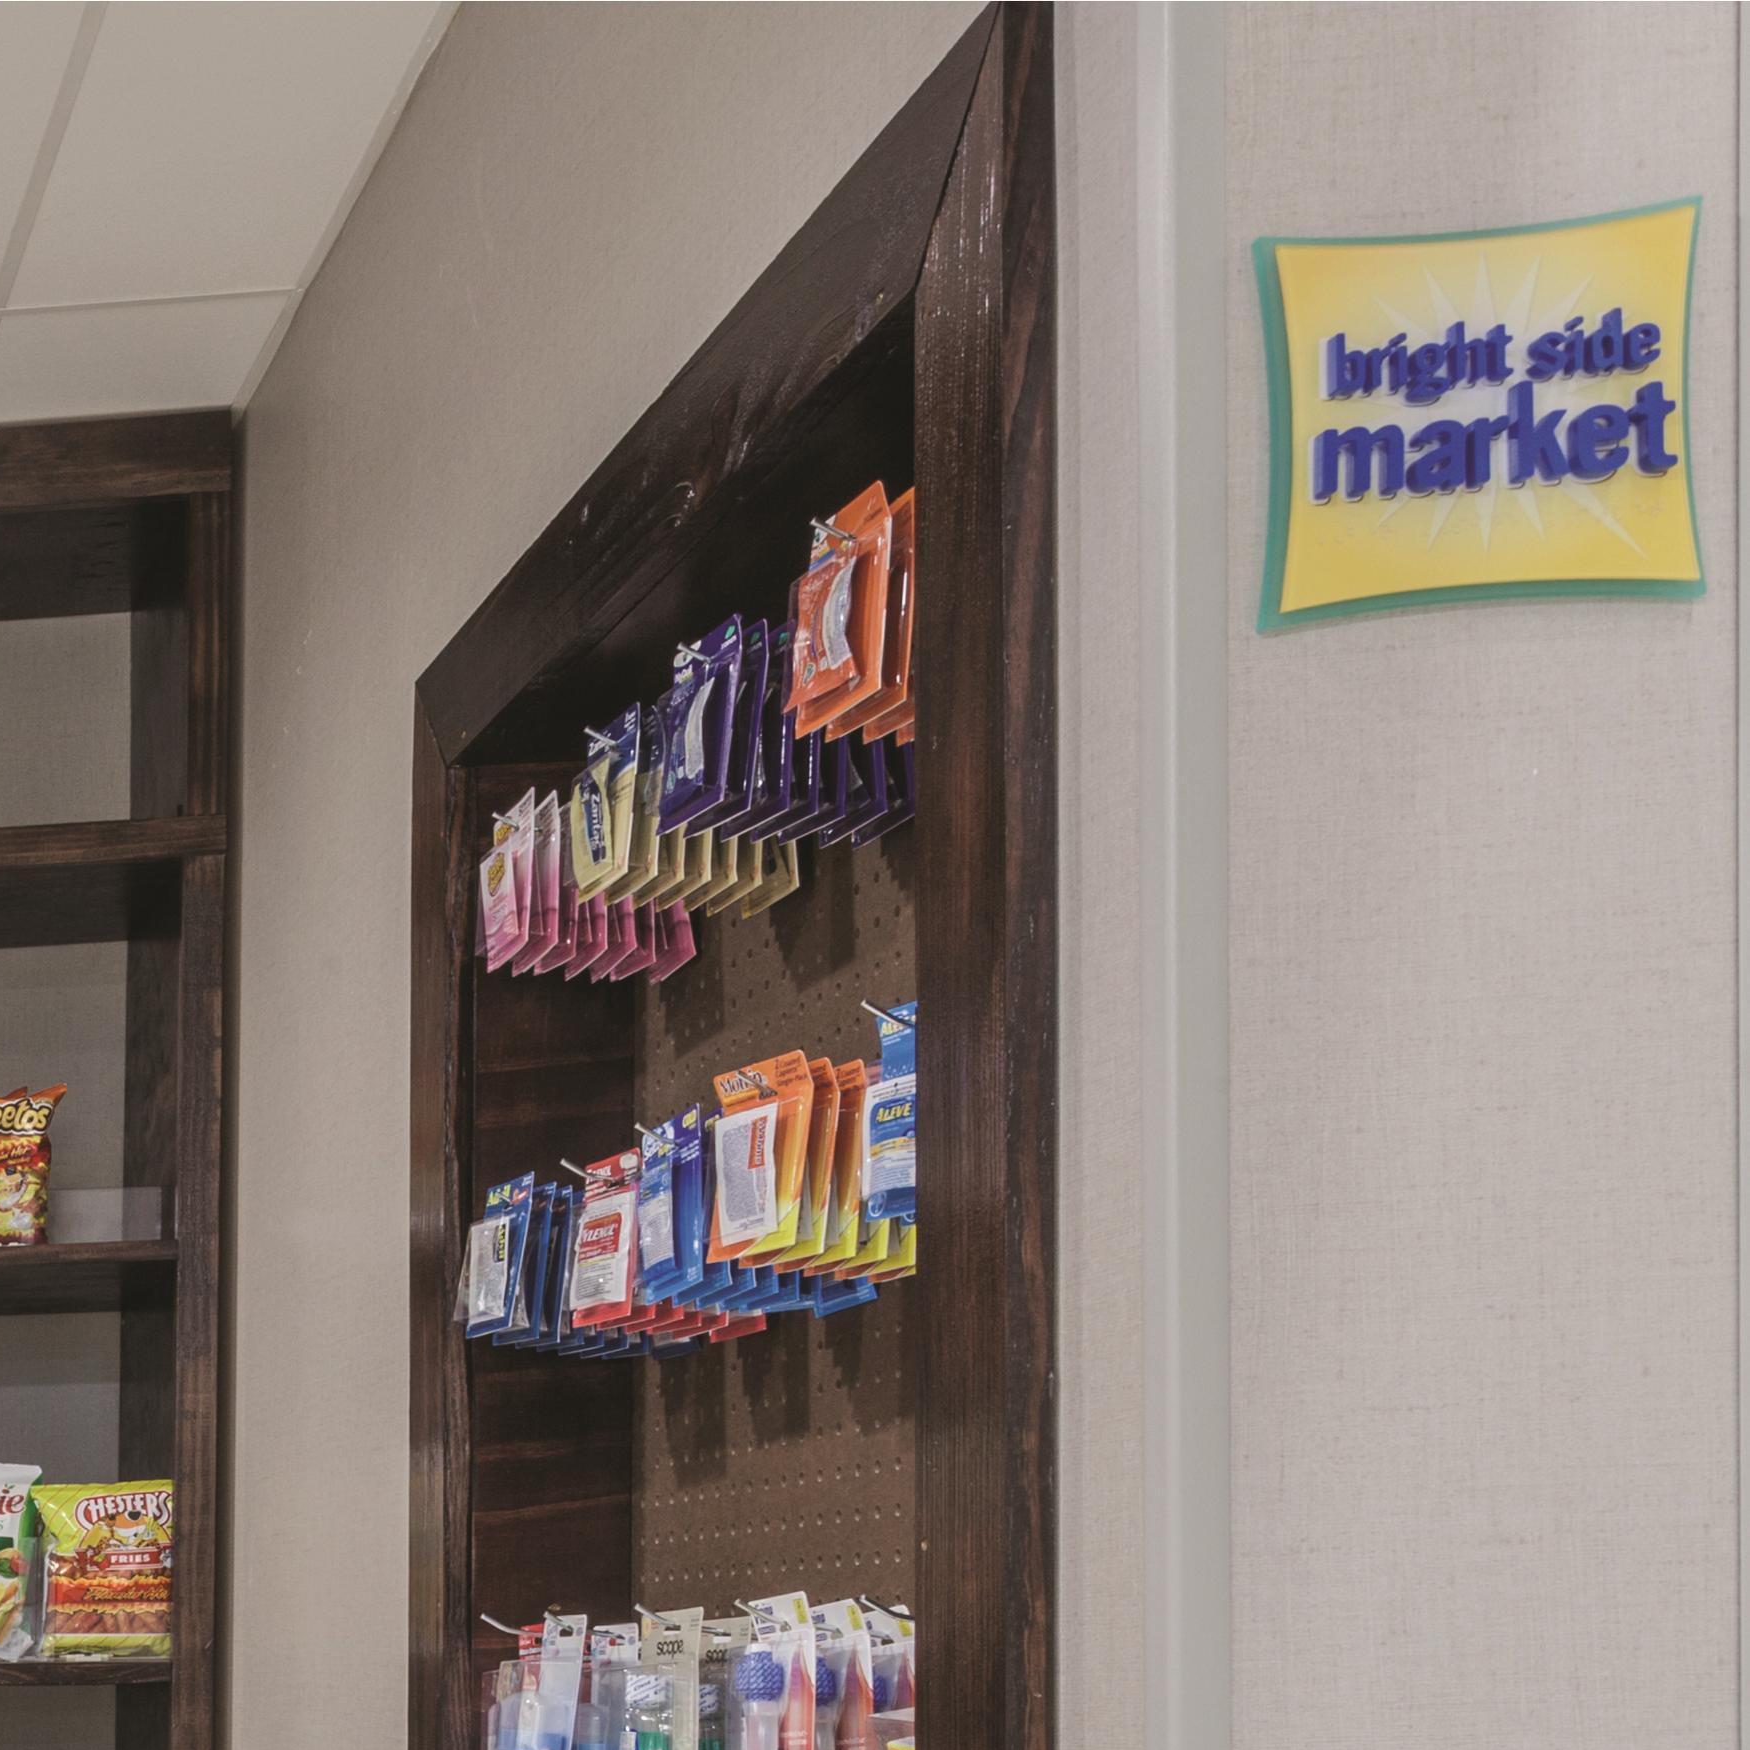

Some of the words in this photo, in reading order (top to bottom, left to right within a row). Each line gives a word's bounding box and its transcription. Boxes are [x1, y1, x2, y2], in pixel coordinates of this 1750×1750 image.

[1320, 320, 1514, 405] bright
[1524, 307, 1663, 382] side
[1311, 380, 1680, 504] market
[875, 1103, 912, 1123] ALEVE
[75, 1490, 172, 1532] CHESTER'S
[110, 1553, 151, 1565] FRIES
[656, 1639, 684, 1658] scope
